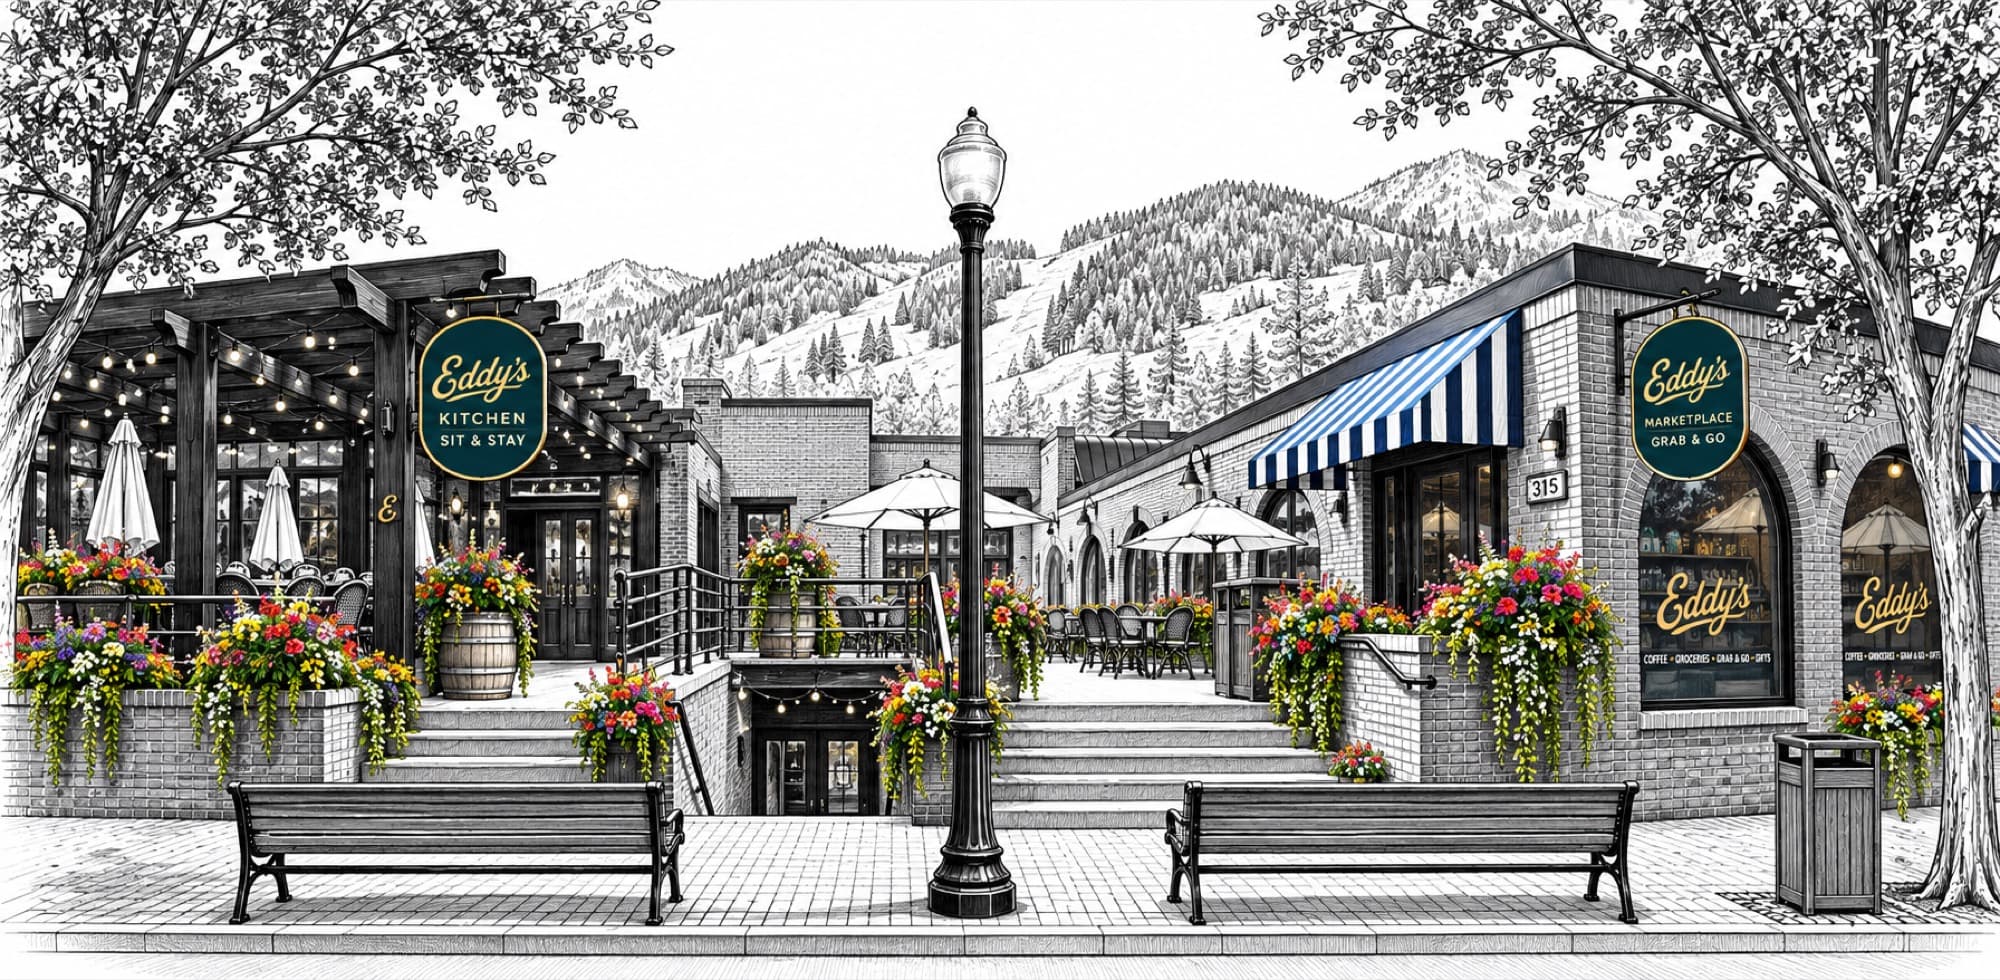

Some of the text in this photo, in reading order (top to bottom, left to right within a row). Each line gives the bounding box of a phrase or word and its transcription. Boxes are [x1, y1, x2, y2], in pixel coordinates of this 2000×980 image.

[432, 354, 531, 403] Eddy's
[1643, 355, 1731, 405] Eddy's
[439, 412, 526, 425] KITCHEN
[1644, 411, 1733, 428] MARKETPLACE
[440, 434, 526, 446] SIT & STAY
[1651, 432, 1726, 447] GRAB & GO
[1532, 477, 1559, 497] 315
[1656, 572, 1751, 636] Eddy's
[1855, 576, 1932, 634] Eddy's
[1643, 653, 1668, 664] COFFEE
